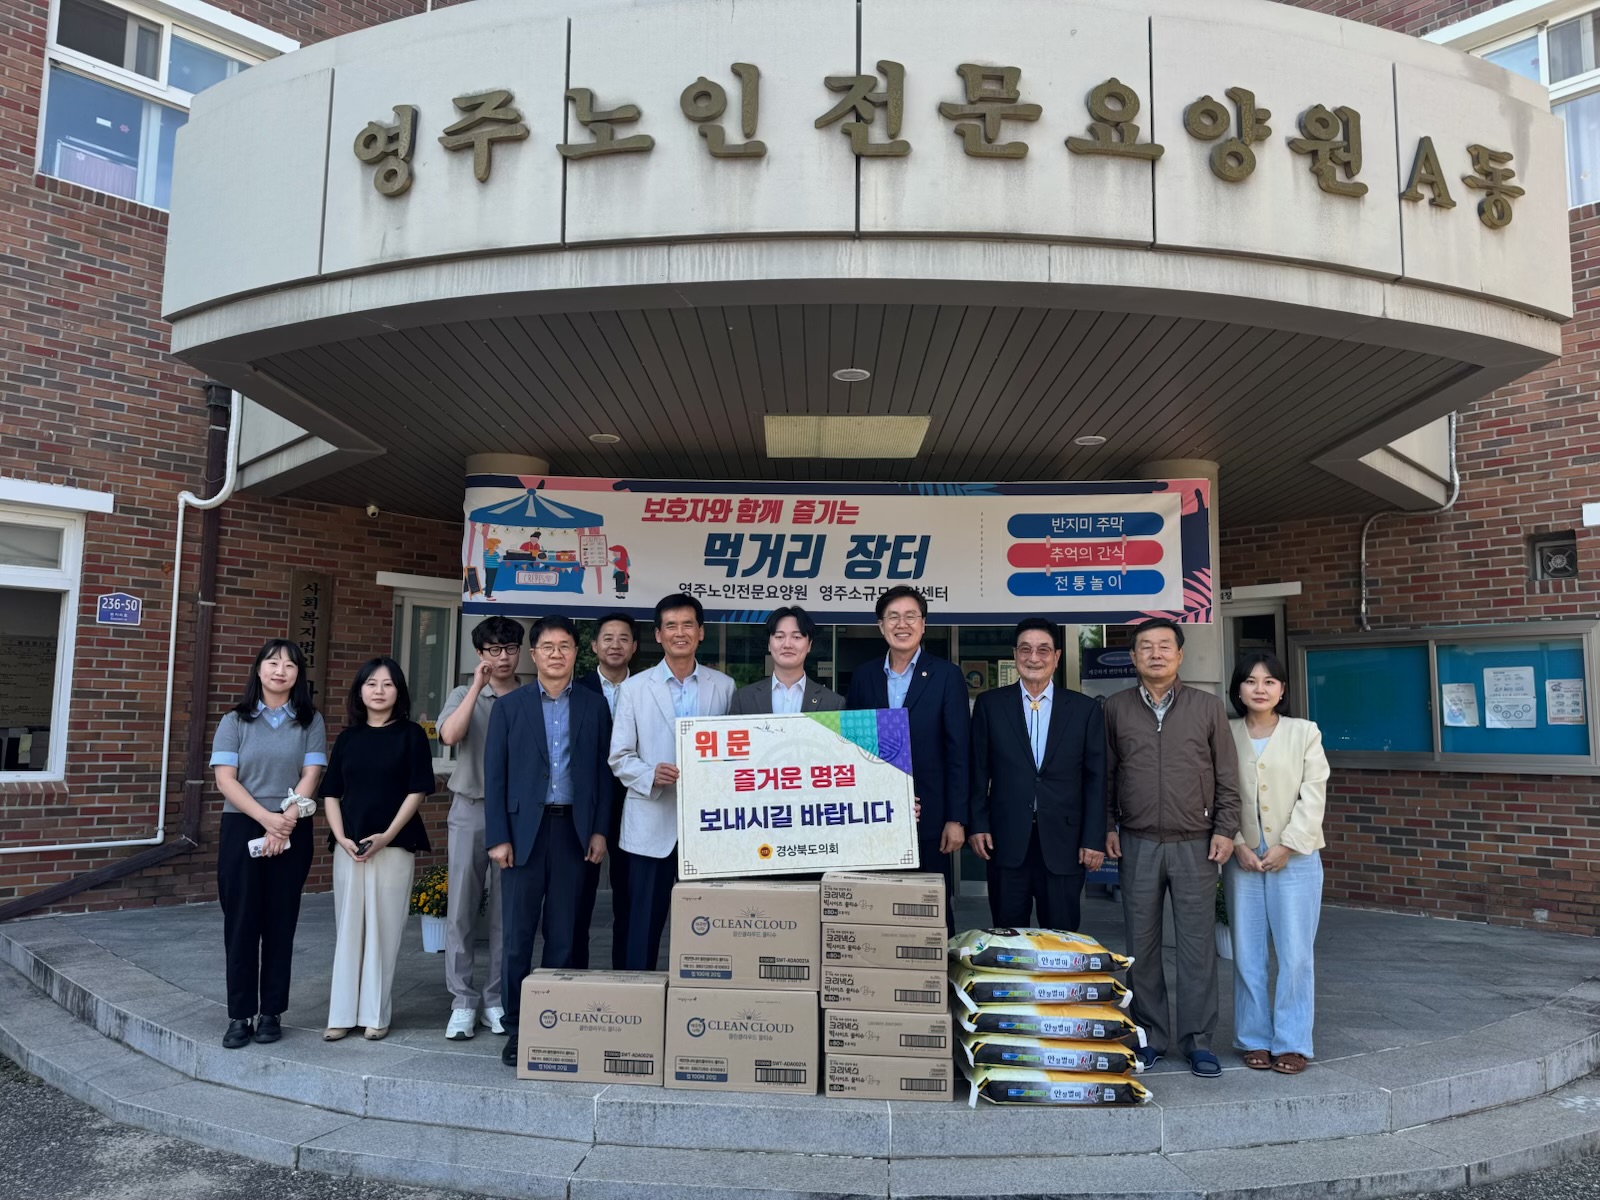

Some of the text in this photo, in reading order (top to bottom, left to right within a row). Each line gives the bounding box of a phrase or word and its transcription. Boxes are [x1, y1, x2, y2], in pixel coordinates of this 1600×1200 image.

[641, 498, 860, 525] 보호자와 함께 즐기는
[1051, 516, 1124, 533] 반지미 주막
[704, 533, 931, 580] 먹거리 장터
[1050, 546, 1125, 563] 추억의 간식
[679, 582, 948, 602] 영주노인전문요양원 영주소규모센터
[102, 598, 137, 611] 236-50
[734, 765, 855, 792] 즐거운 명절
[700, 800, 894, 832] 보내시길 바랍니다
[776, 843, 839, 857] 경상북도의회
[824, 891, 853, 900] 크리넥스
[712, 919, 797, 930] CLEAN CLOUD
[827, 934, 856, 942] 크리넥스
[825, 977, 854, 985] 크리넥스
[560, 1012, 642, 1025] CLEAN CLOUD
[708, 1020, 794, 1033] CLEAN CLOUD
[829, 1022, 858, 1030] 크리넥스
[830, 1066, 859, 1075] 크리넥스
